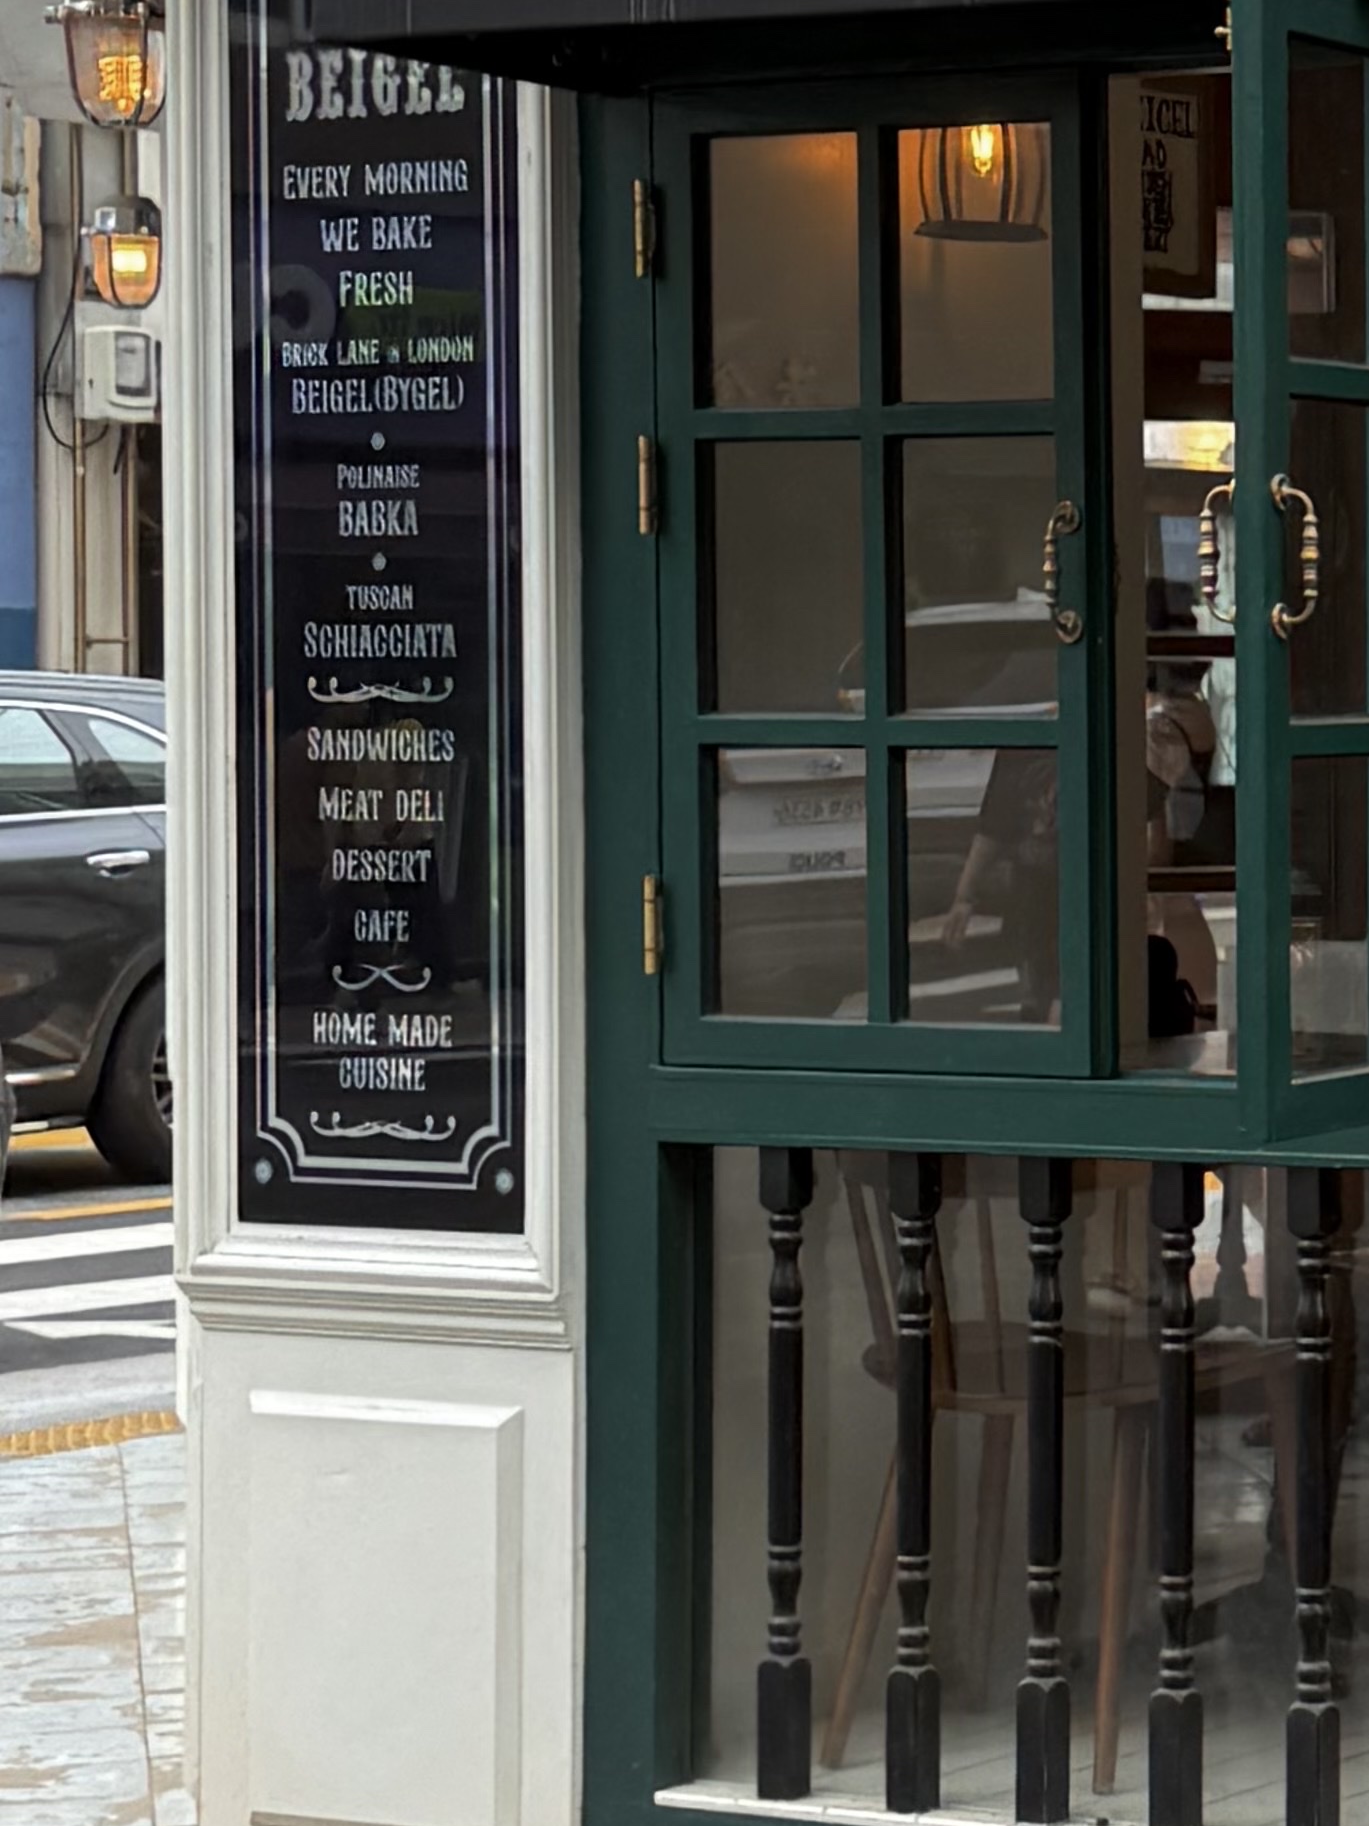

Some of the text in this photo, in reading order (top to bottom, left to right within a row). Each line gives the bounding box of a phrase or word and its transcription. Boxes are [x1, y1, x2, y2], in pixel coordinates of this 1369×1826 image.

[285, 50, 465, 122] BEIGEL
[283, 159, 469, 200] EVERY MORNING
[320, 215, 432, 253] WE BAKE
[339, 271, 414, 307] FRESH
[282, 340, 329, 368] BRICK
[337, 339, 380, 366] LANE
[407, 337, 474, 364] LONDON
[339, 500, 418, 537] BABKA
[346, 585, 413, 612] TUSCAN
[304, 621, 457, 659] SCHIACCIATA
[307, 728, 455, 762] SANDWICHES
[319, 788, 444, 822] MEAT DELI
[332, 849, 431, 883] DESSERT
[354, 909, 410, 943] CAFE
[312, 1011, 452, 1048] HOME MADE
[339, 1058, 425, 1092] CUISINE
